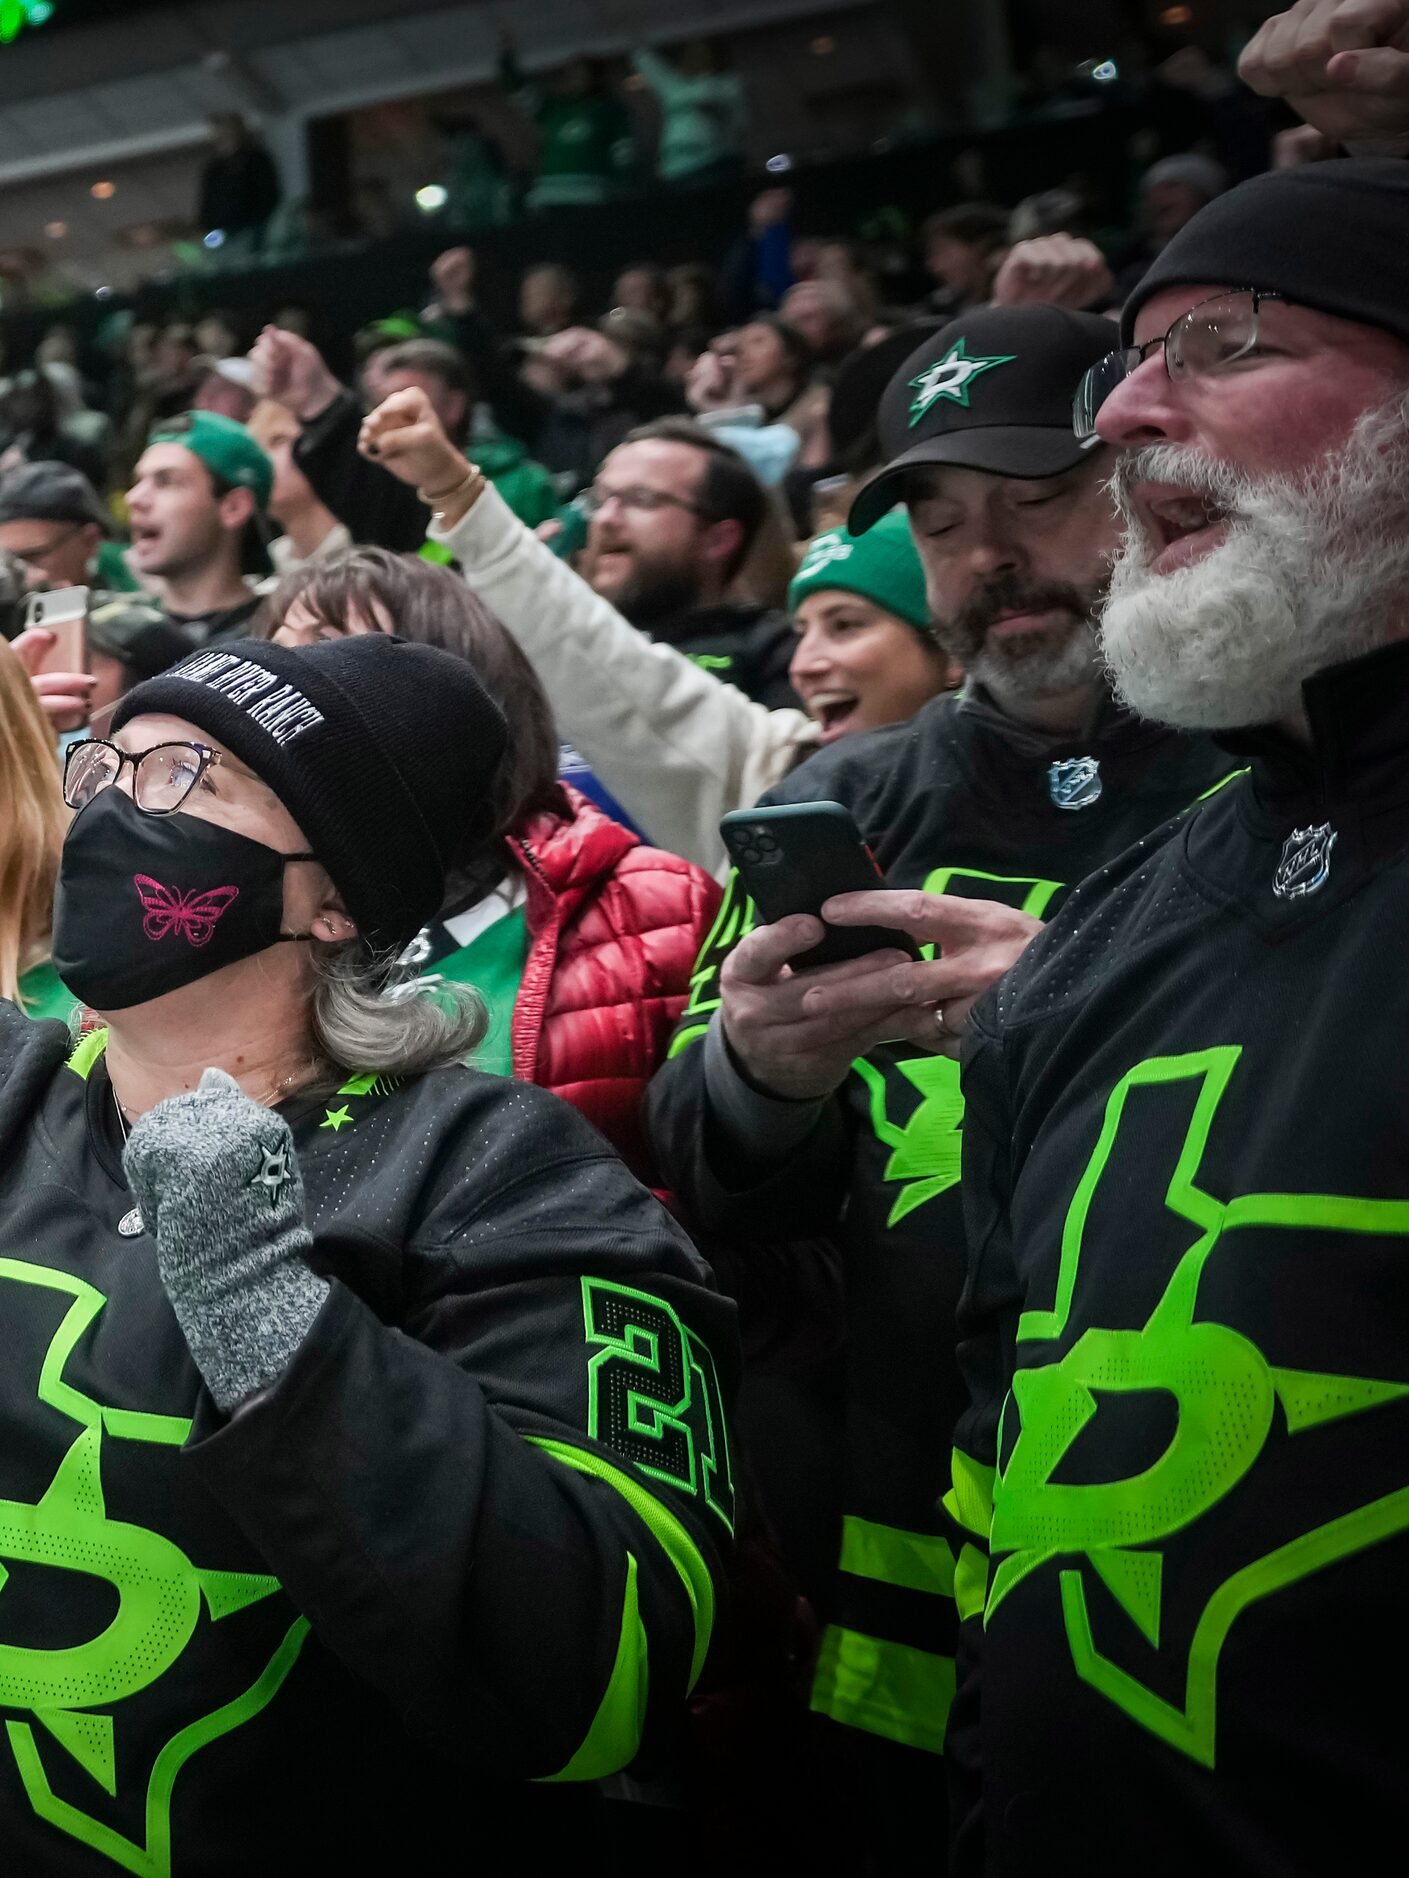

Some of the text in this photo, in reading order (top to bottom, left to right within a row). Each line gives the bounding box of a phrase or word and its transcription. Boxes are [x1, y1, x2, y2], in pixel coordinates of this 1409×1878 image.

[206, 660, 278, 706] RIVER
[246, 684, 325, 747] RANCH
[580, 1275, 736, 1540] 21
